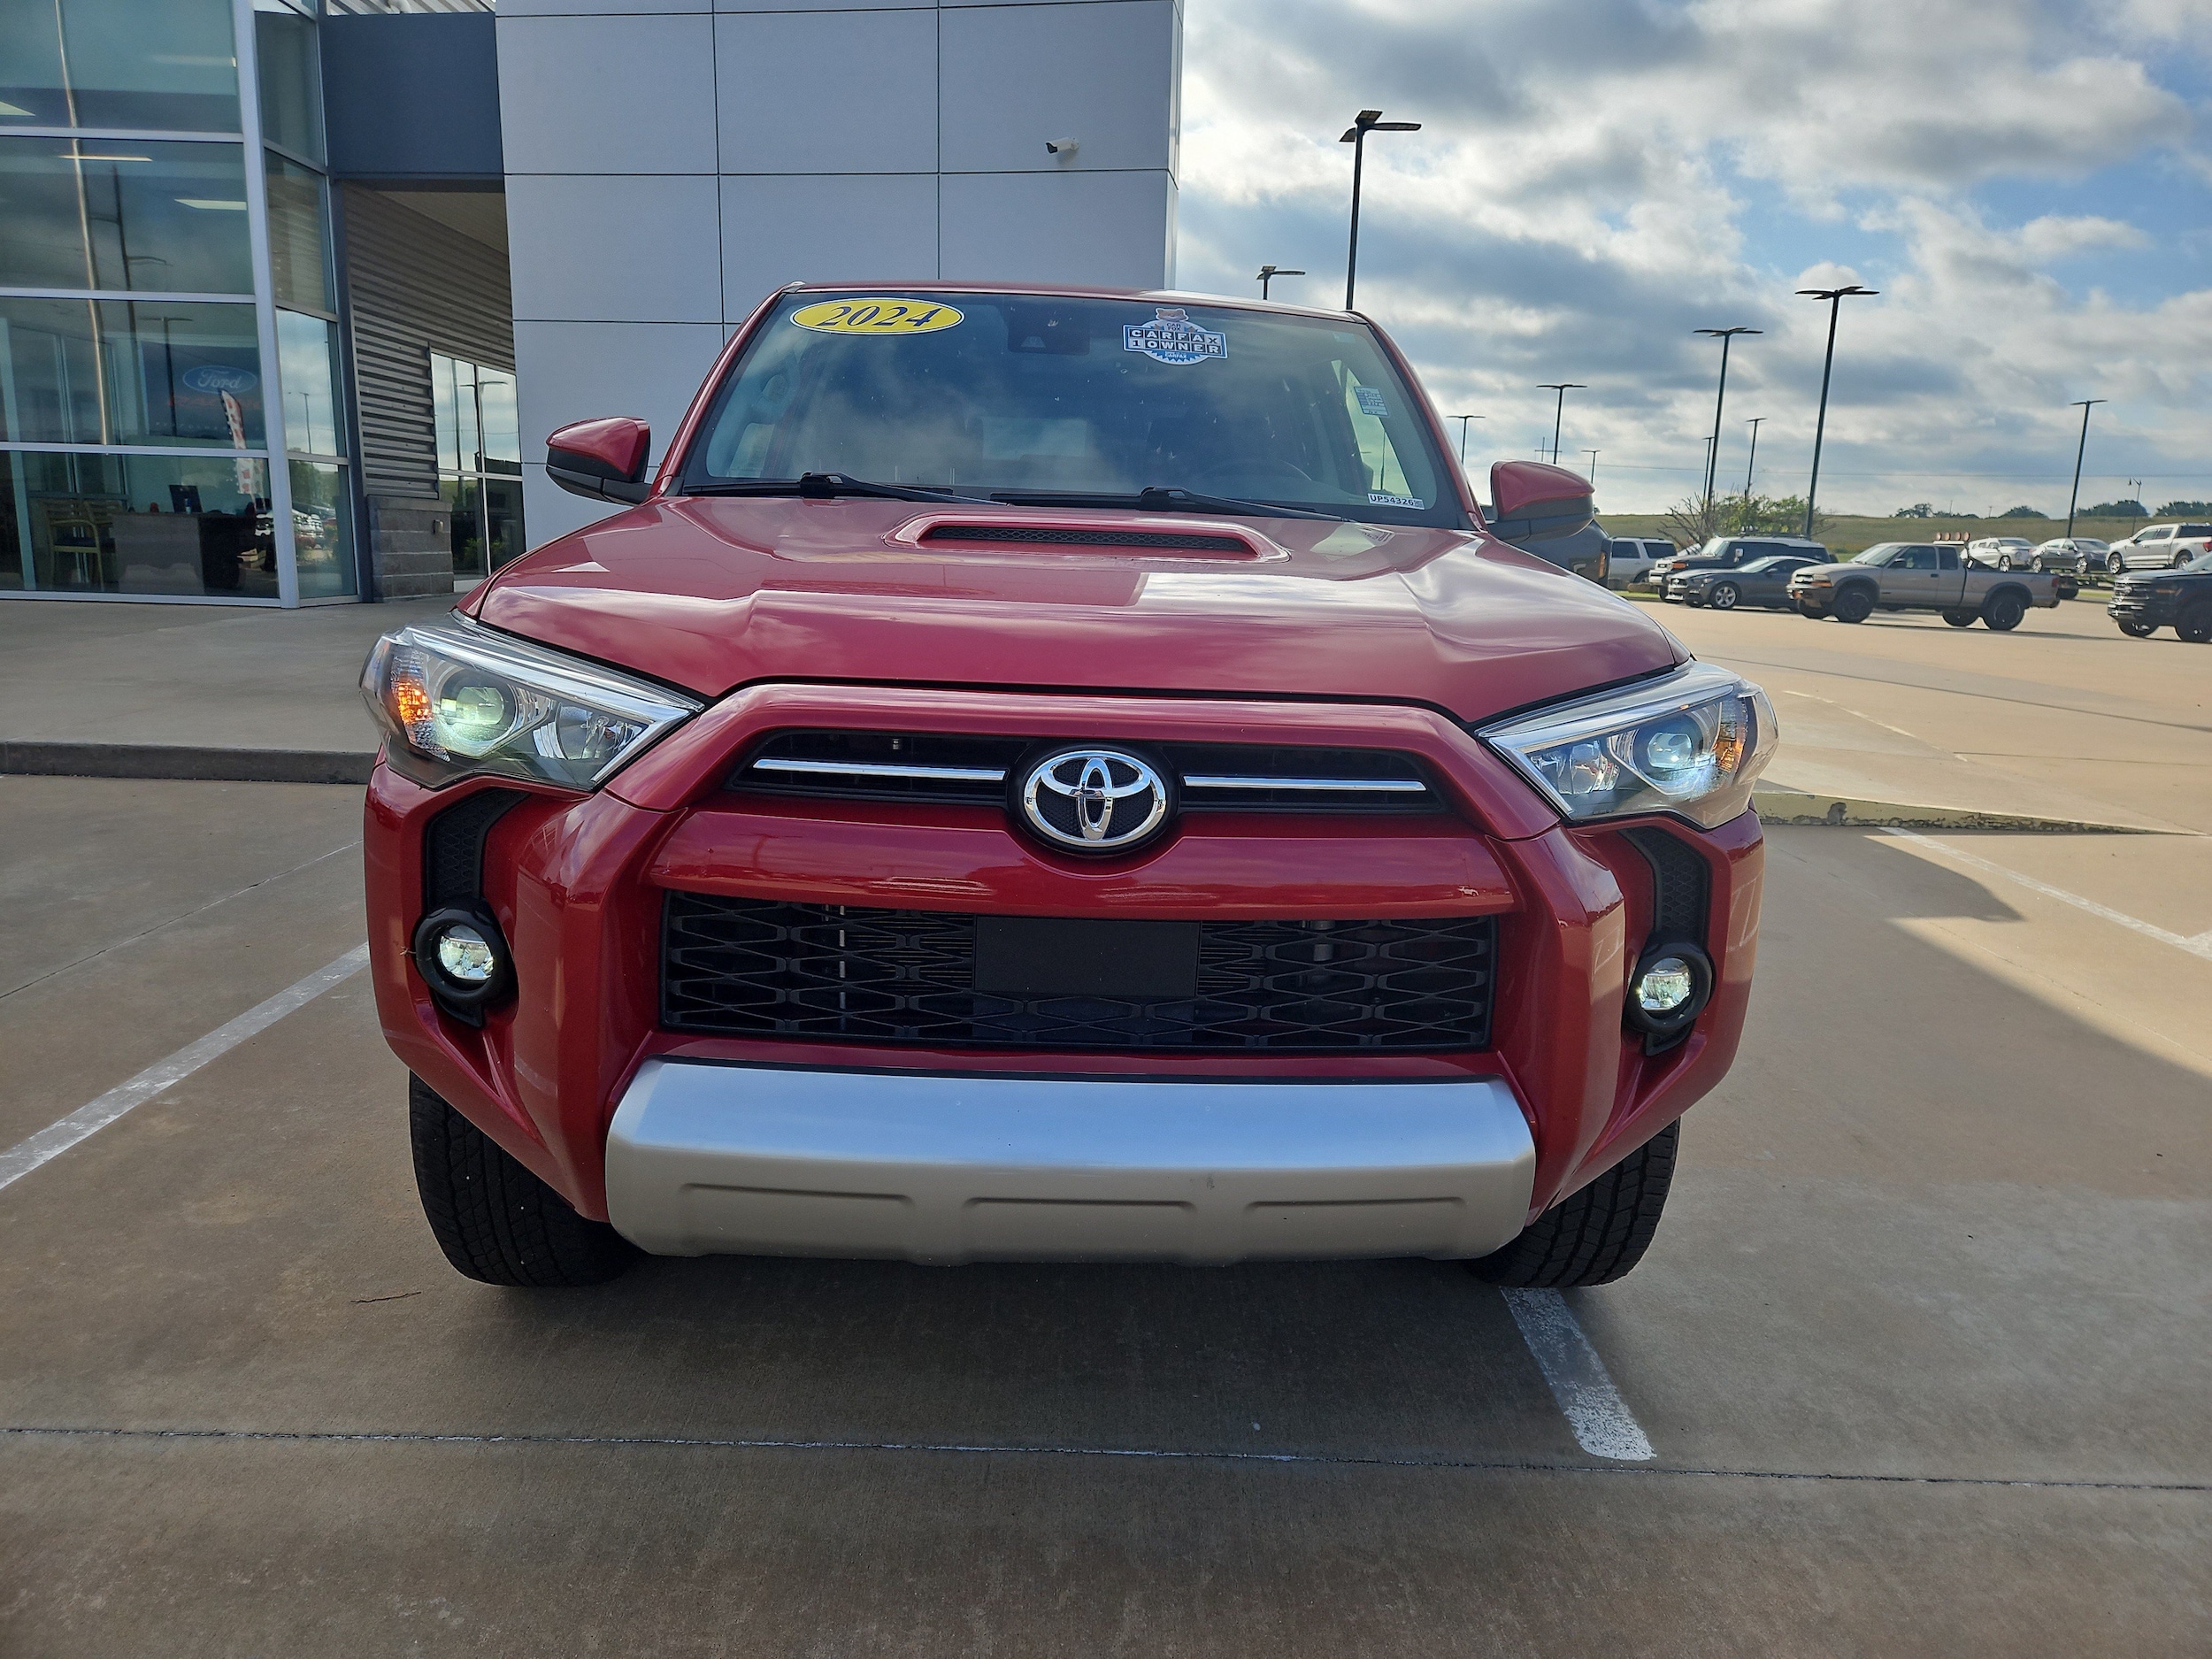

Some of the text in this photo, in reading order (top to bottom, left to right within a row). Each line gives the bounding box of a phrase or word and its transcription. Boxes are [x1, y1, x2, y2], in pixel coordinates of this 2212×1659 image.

[815, 305, 943, 327] 2024
[1130, 329, 1218, 344] CARFAX
[1146, 340, 1219, 354] OWNER
[197, 368, 243, 388] Ford
[1370, 495, 1414, 506] UP54326
